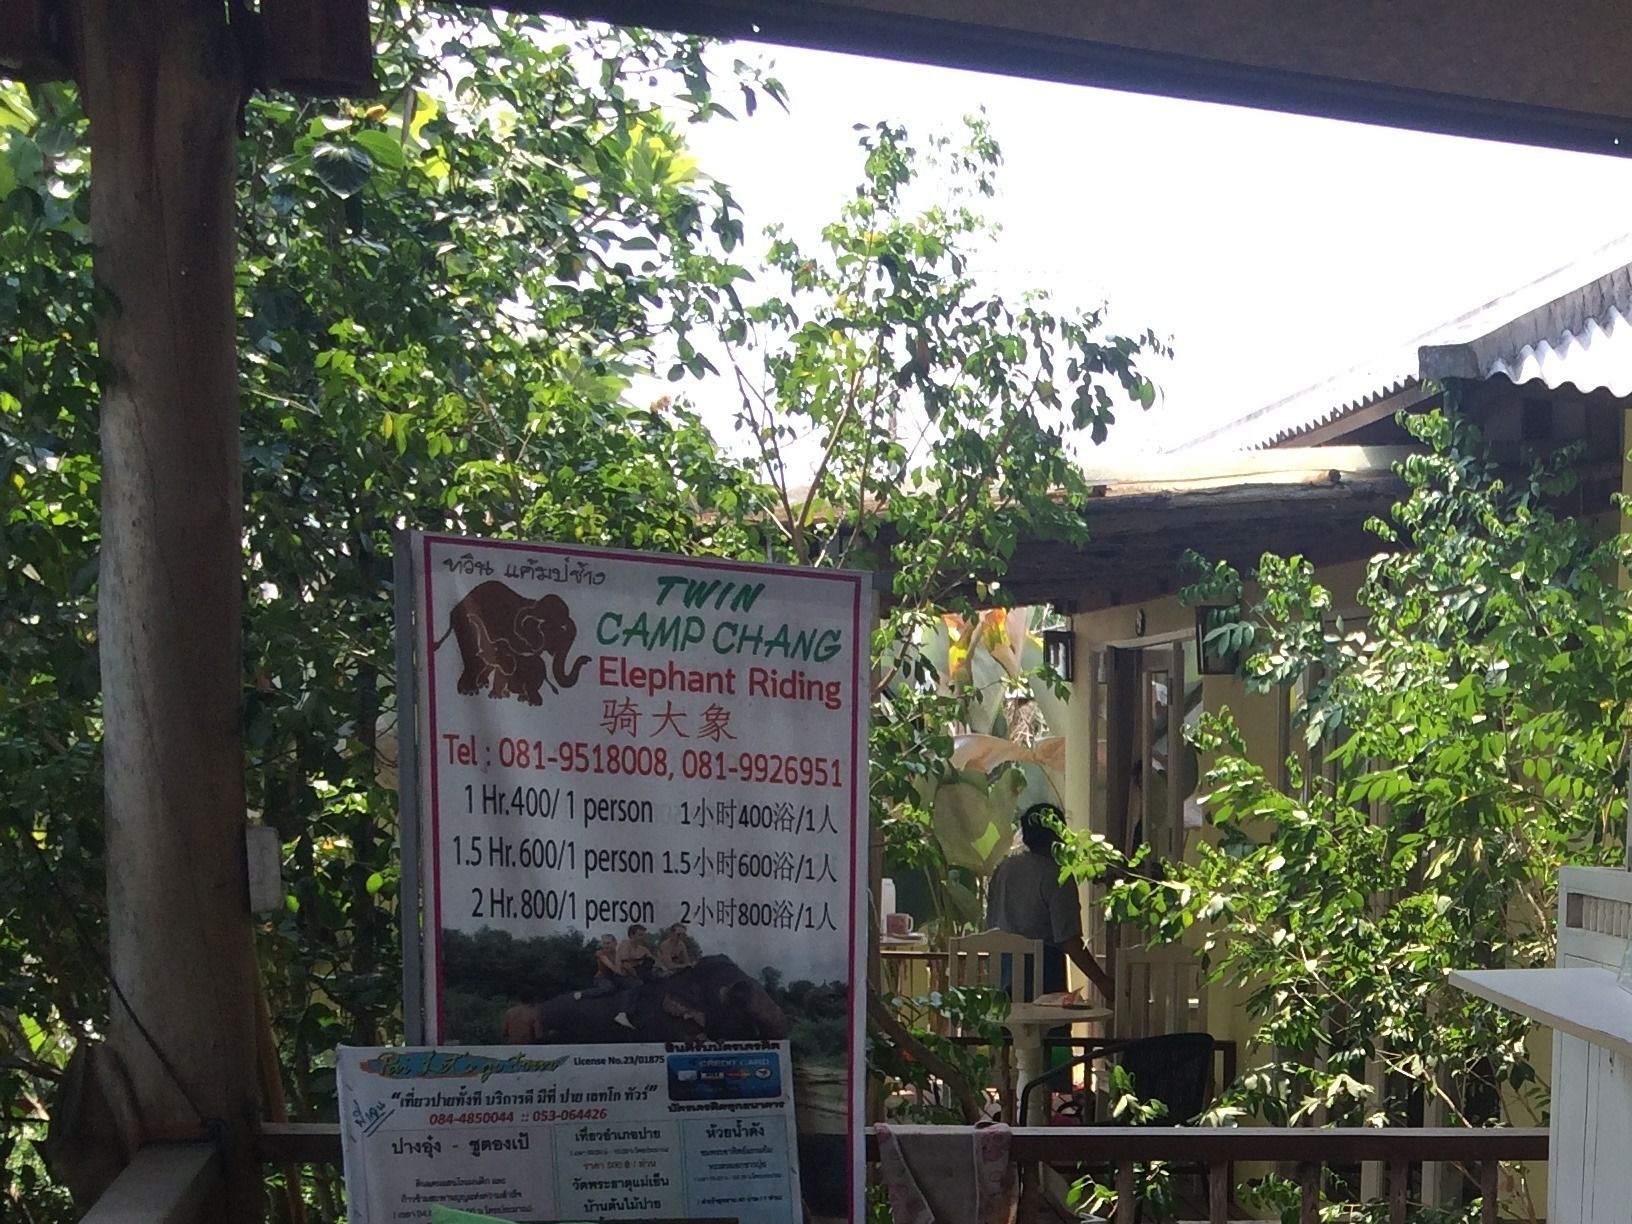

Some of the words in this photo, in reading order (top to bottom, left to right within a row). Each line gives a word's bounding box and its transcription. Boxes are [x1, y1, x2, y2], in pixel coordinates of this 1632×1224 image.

[657, 576, 765, 613] TWIN
[597, 612, 705, 651] CAMP
[713, 622, 842, 663] CHANG
[599, 656, 736, 696] Elephant
[749, 667, 841, 710] Riding
[600, 699, 738, 743] 骑大象
[499, 738, 674, 781] 081-9518008,
[682, 750, 843, 788] 081-9926951
[465, 785, 474, 814] 1
[584, 797, 654, 828] person
[453, 836, 483, 867] 1.5
[585, 848, 655, 879] person
[471, 888, 484, 918] 2
[585, 899, 656, 929] person
[574, 1056, 606, 1066] License
